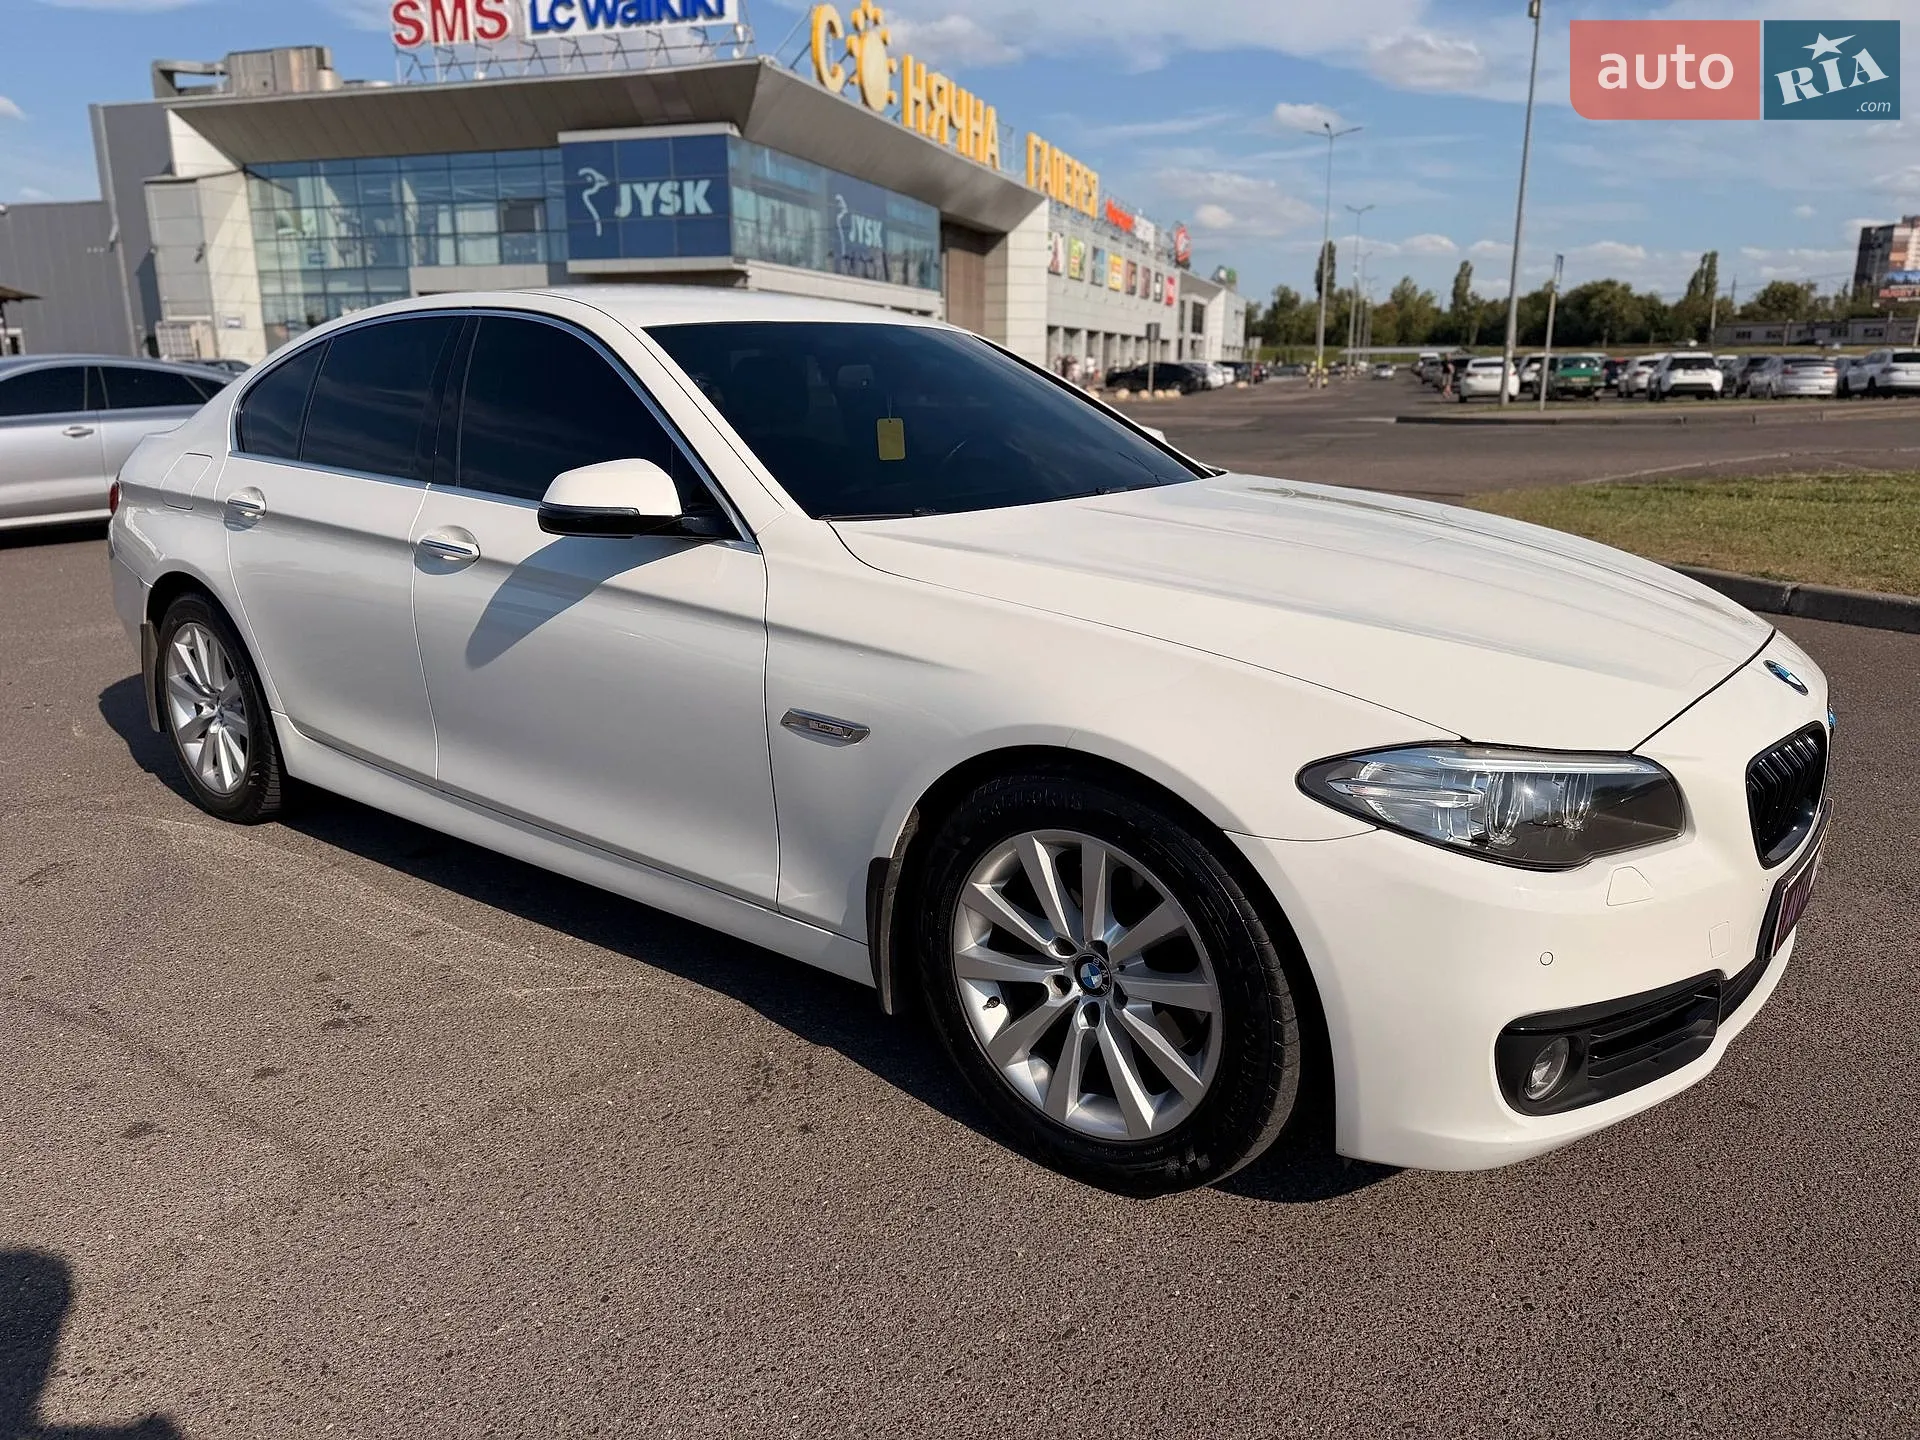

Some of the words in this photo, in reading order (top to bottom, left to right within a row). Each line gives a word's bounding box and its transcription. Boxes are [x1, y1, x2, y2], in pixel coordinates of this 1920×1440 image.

[392, 0, 509, 46] SMS
[614, 179, 713, 219] JYSK
[848, 213, 884, 249] JYSK
